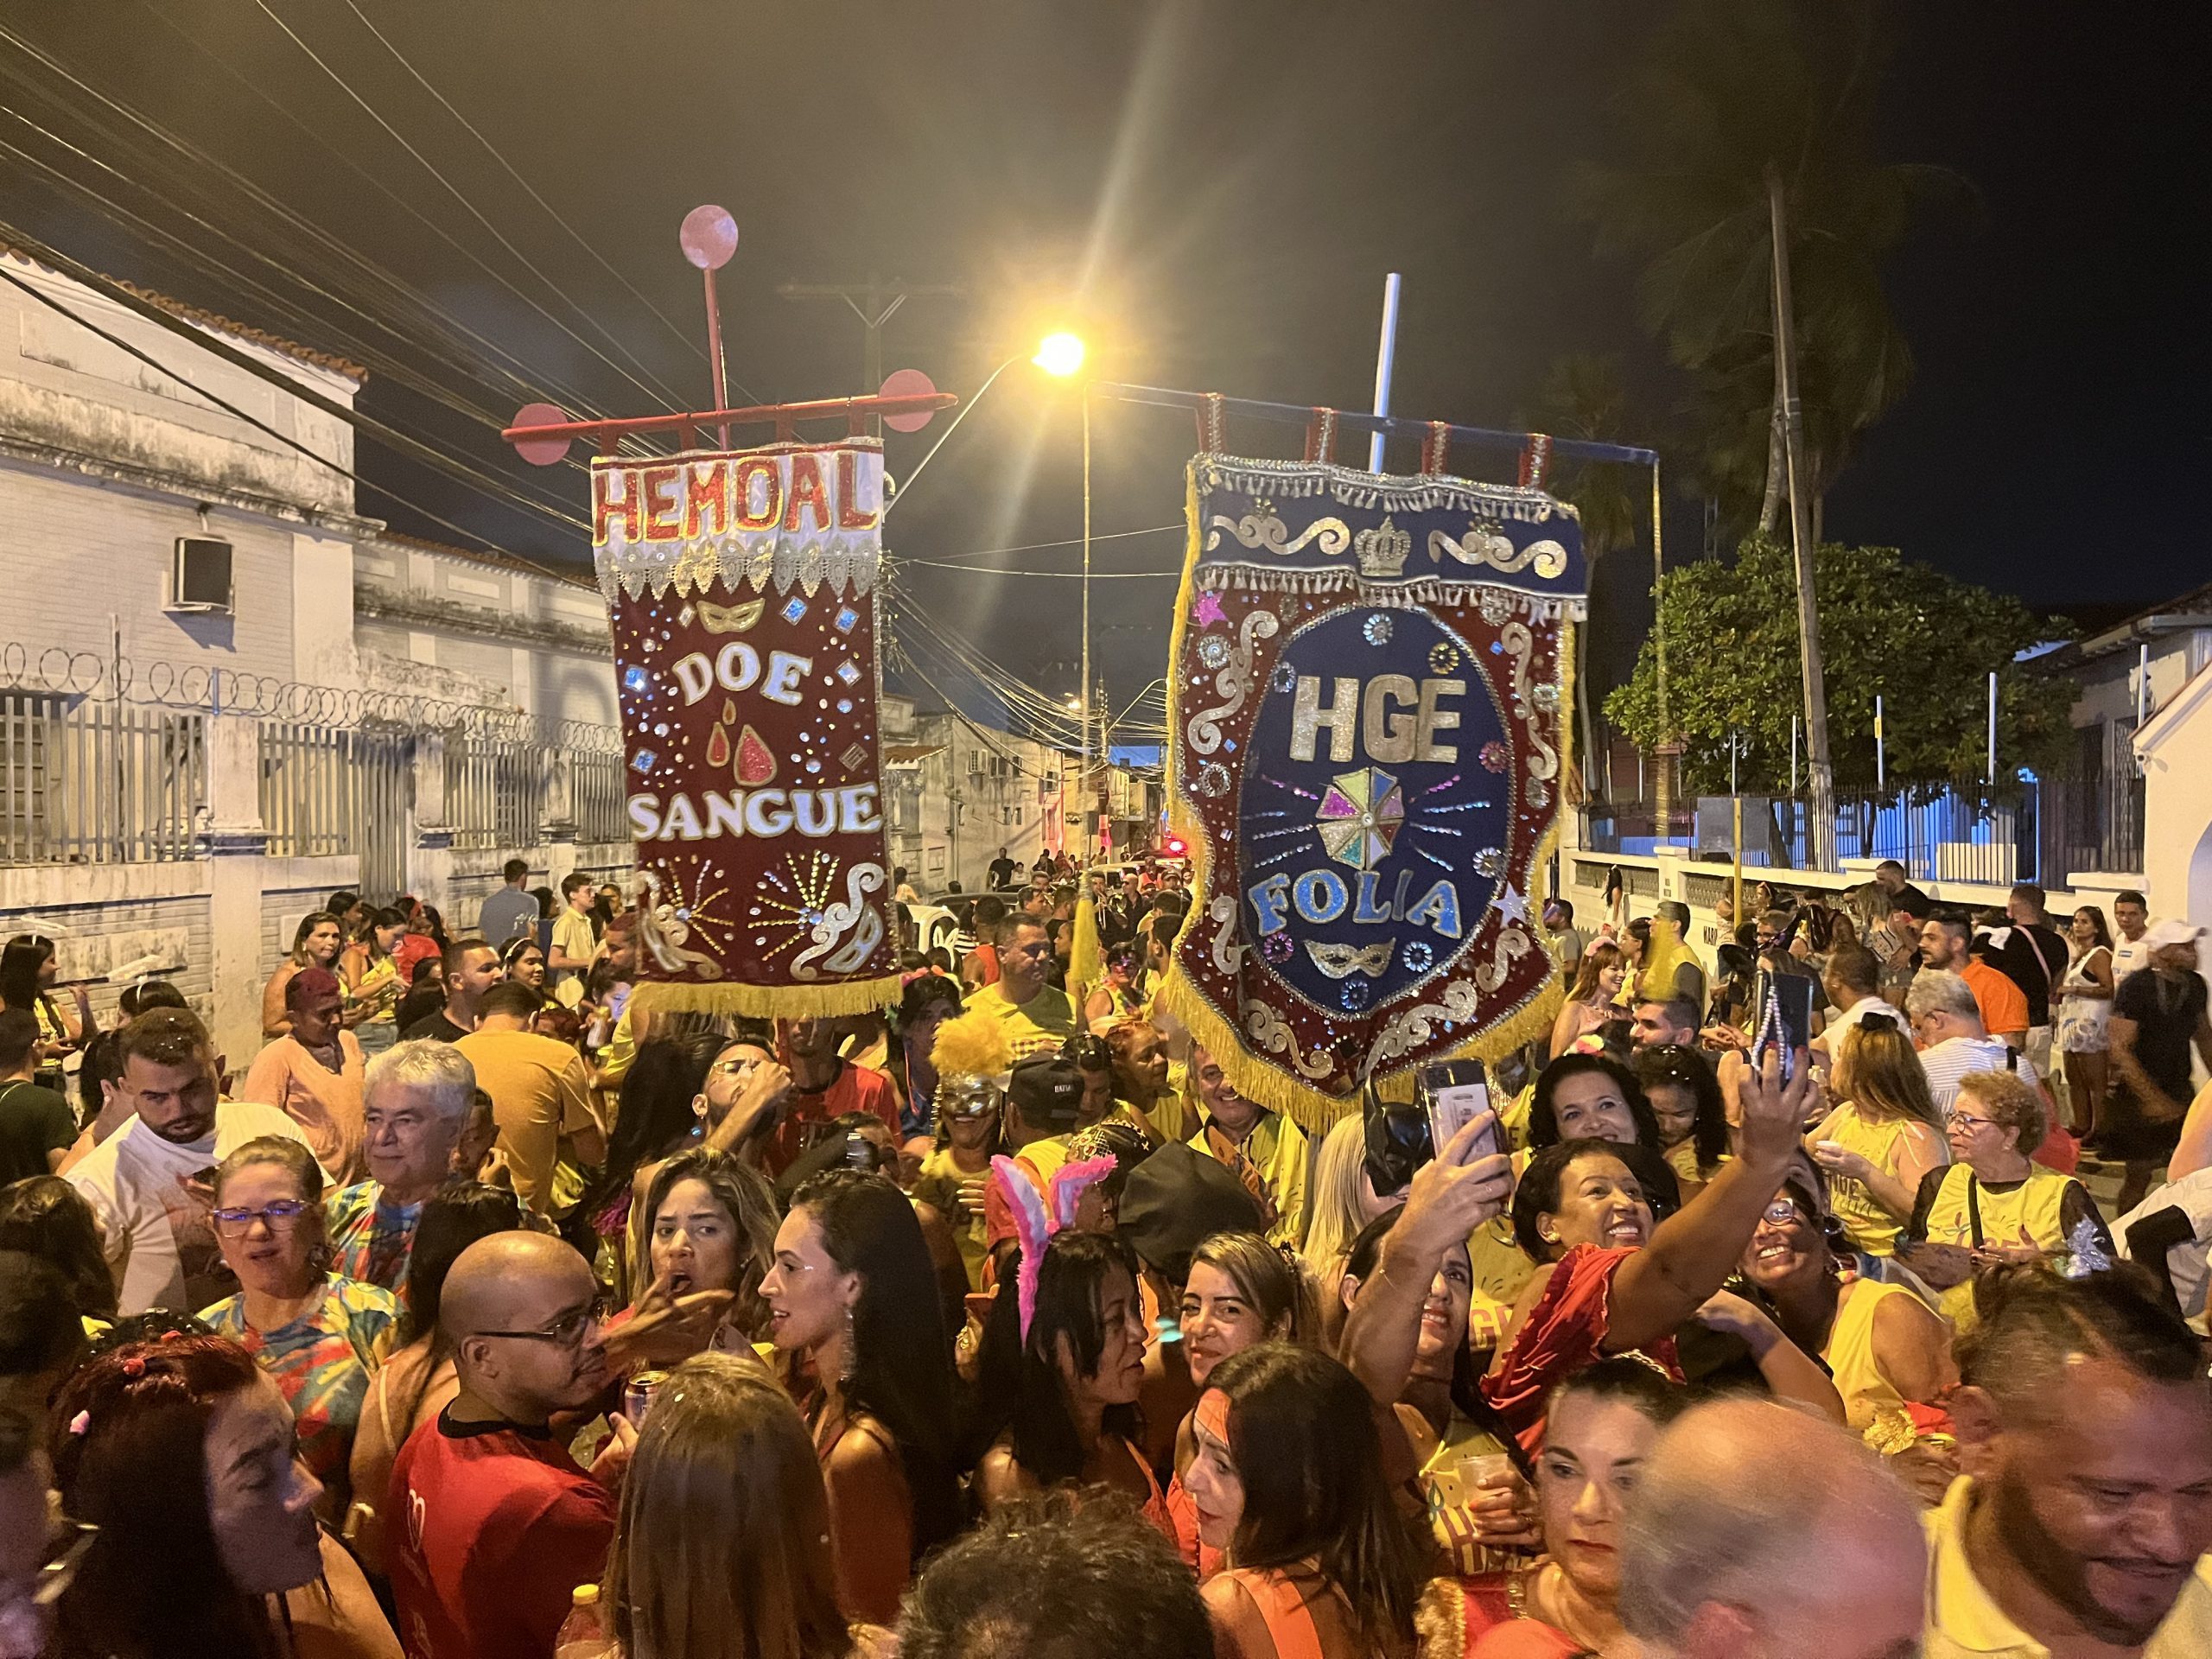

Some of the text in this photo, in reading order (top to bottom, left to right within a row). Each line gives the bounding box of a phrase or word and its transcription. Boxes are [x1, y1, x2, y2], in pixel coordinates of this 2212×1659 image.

[593, 452, 878, 547] HEMOAL
[671, 640, 813, 707] DOE
[1289, 674, 1467, 764] HGE
[626, 784, 884, 842] SANGUE
[1247, 868, 1463, 939] FOLIA
